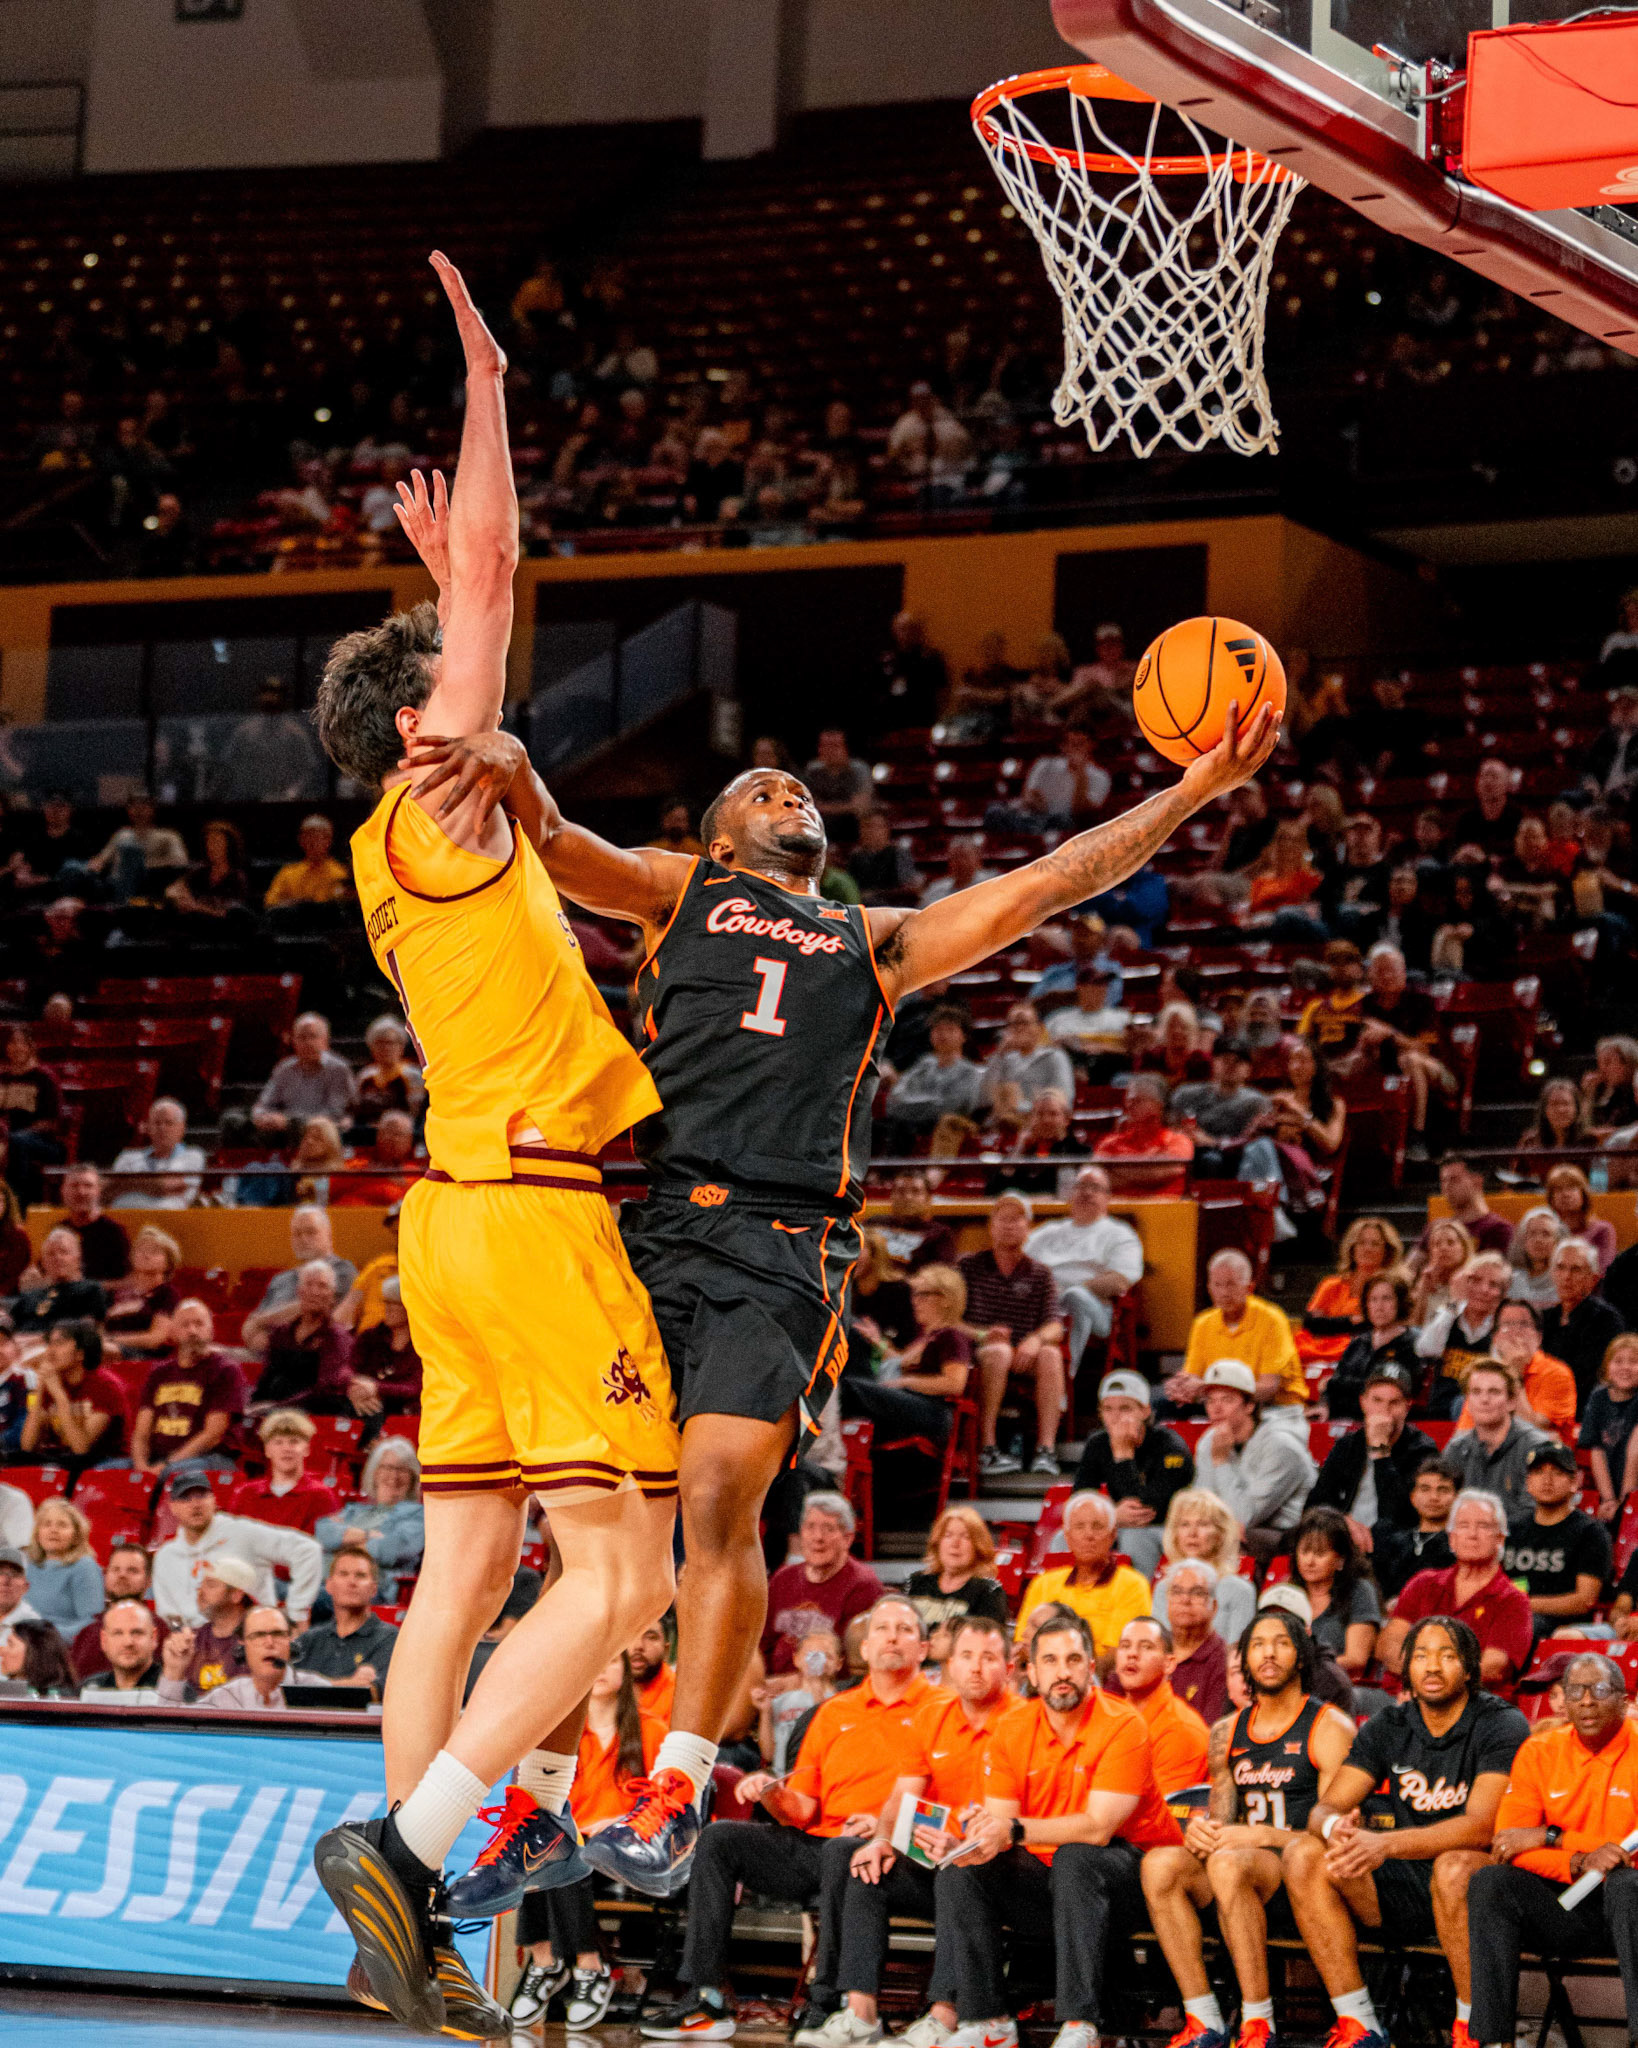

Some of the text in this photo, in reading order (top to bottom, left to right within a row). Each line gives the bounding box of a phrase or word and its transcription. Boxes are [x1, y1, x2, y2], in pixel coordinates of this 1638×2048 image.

[706, 897, 846, 955] Cowboys
[740, 955, 789, 1037] 1
[1233, 1758, 1296, 1788] Cowboys
[1399, 1770, 1468, 1812] Pokes
[1245, 1791, 1292, 1831] 21
[0, 1774, 388, 1933] ESSIV
